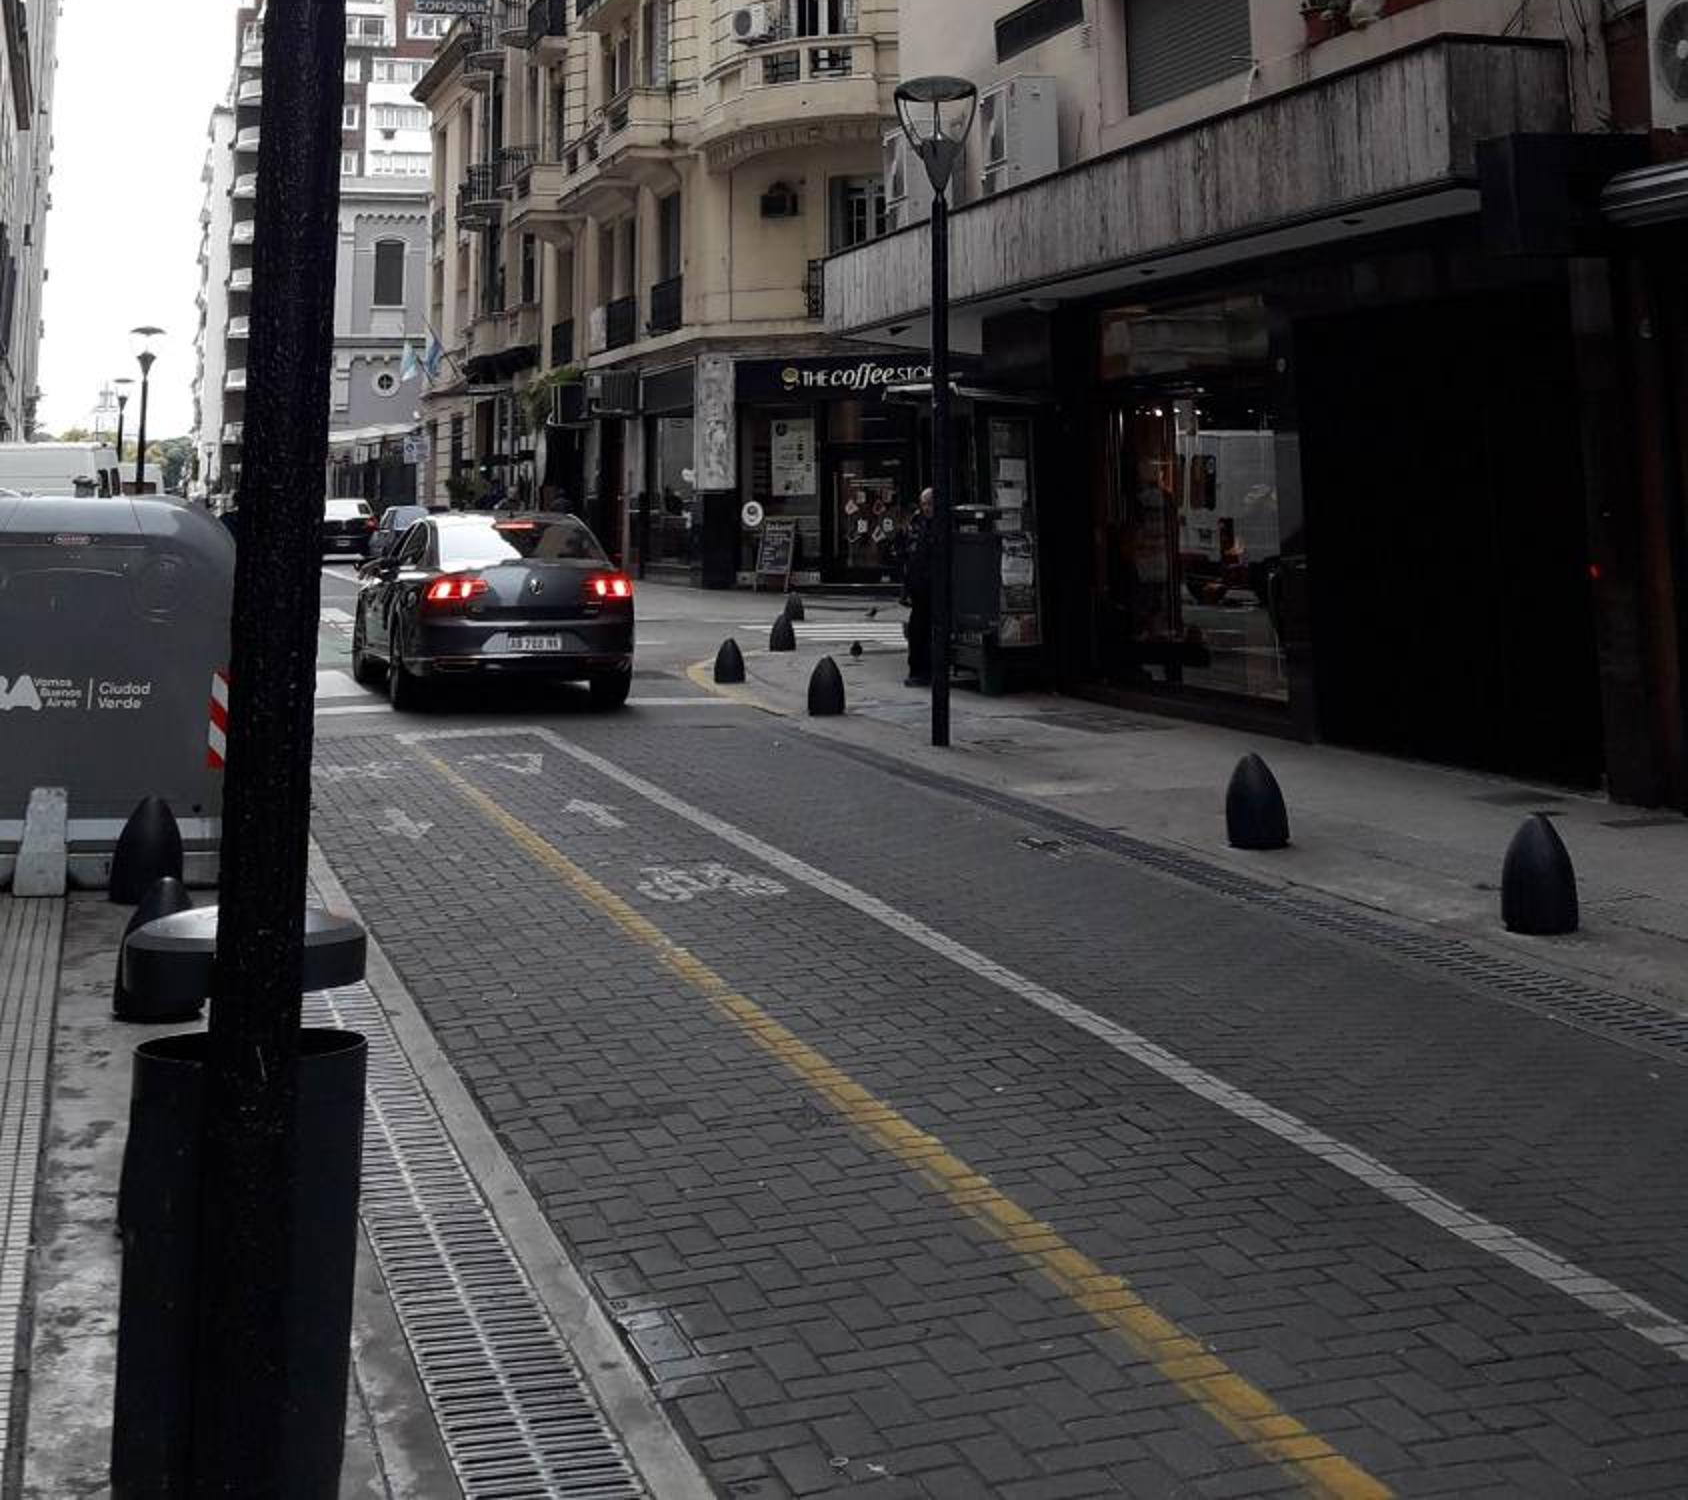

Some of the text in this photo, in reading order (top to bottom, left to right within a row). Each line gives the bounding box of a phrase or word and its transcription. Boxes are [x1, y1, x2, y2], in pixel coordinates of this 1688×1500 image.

[802, 369, 829, 387] THE
[830, 362, 894, 390] coffee
[34, 678, 73, 688] Vamos
[99, 681, 152, 695] Ciudad
[40, 687, 82, 699] Buenos
[46, 698, 77, 709] Aires
[97, 696, 142, 709] Verde
